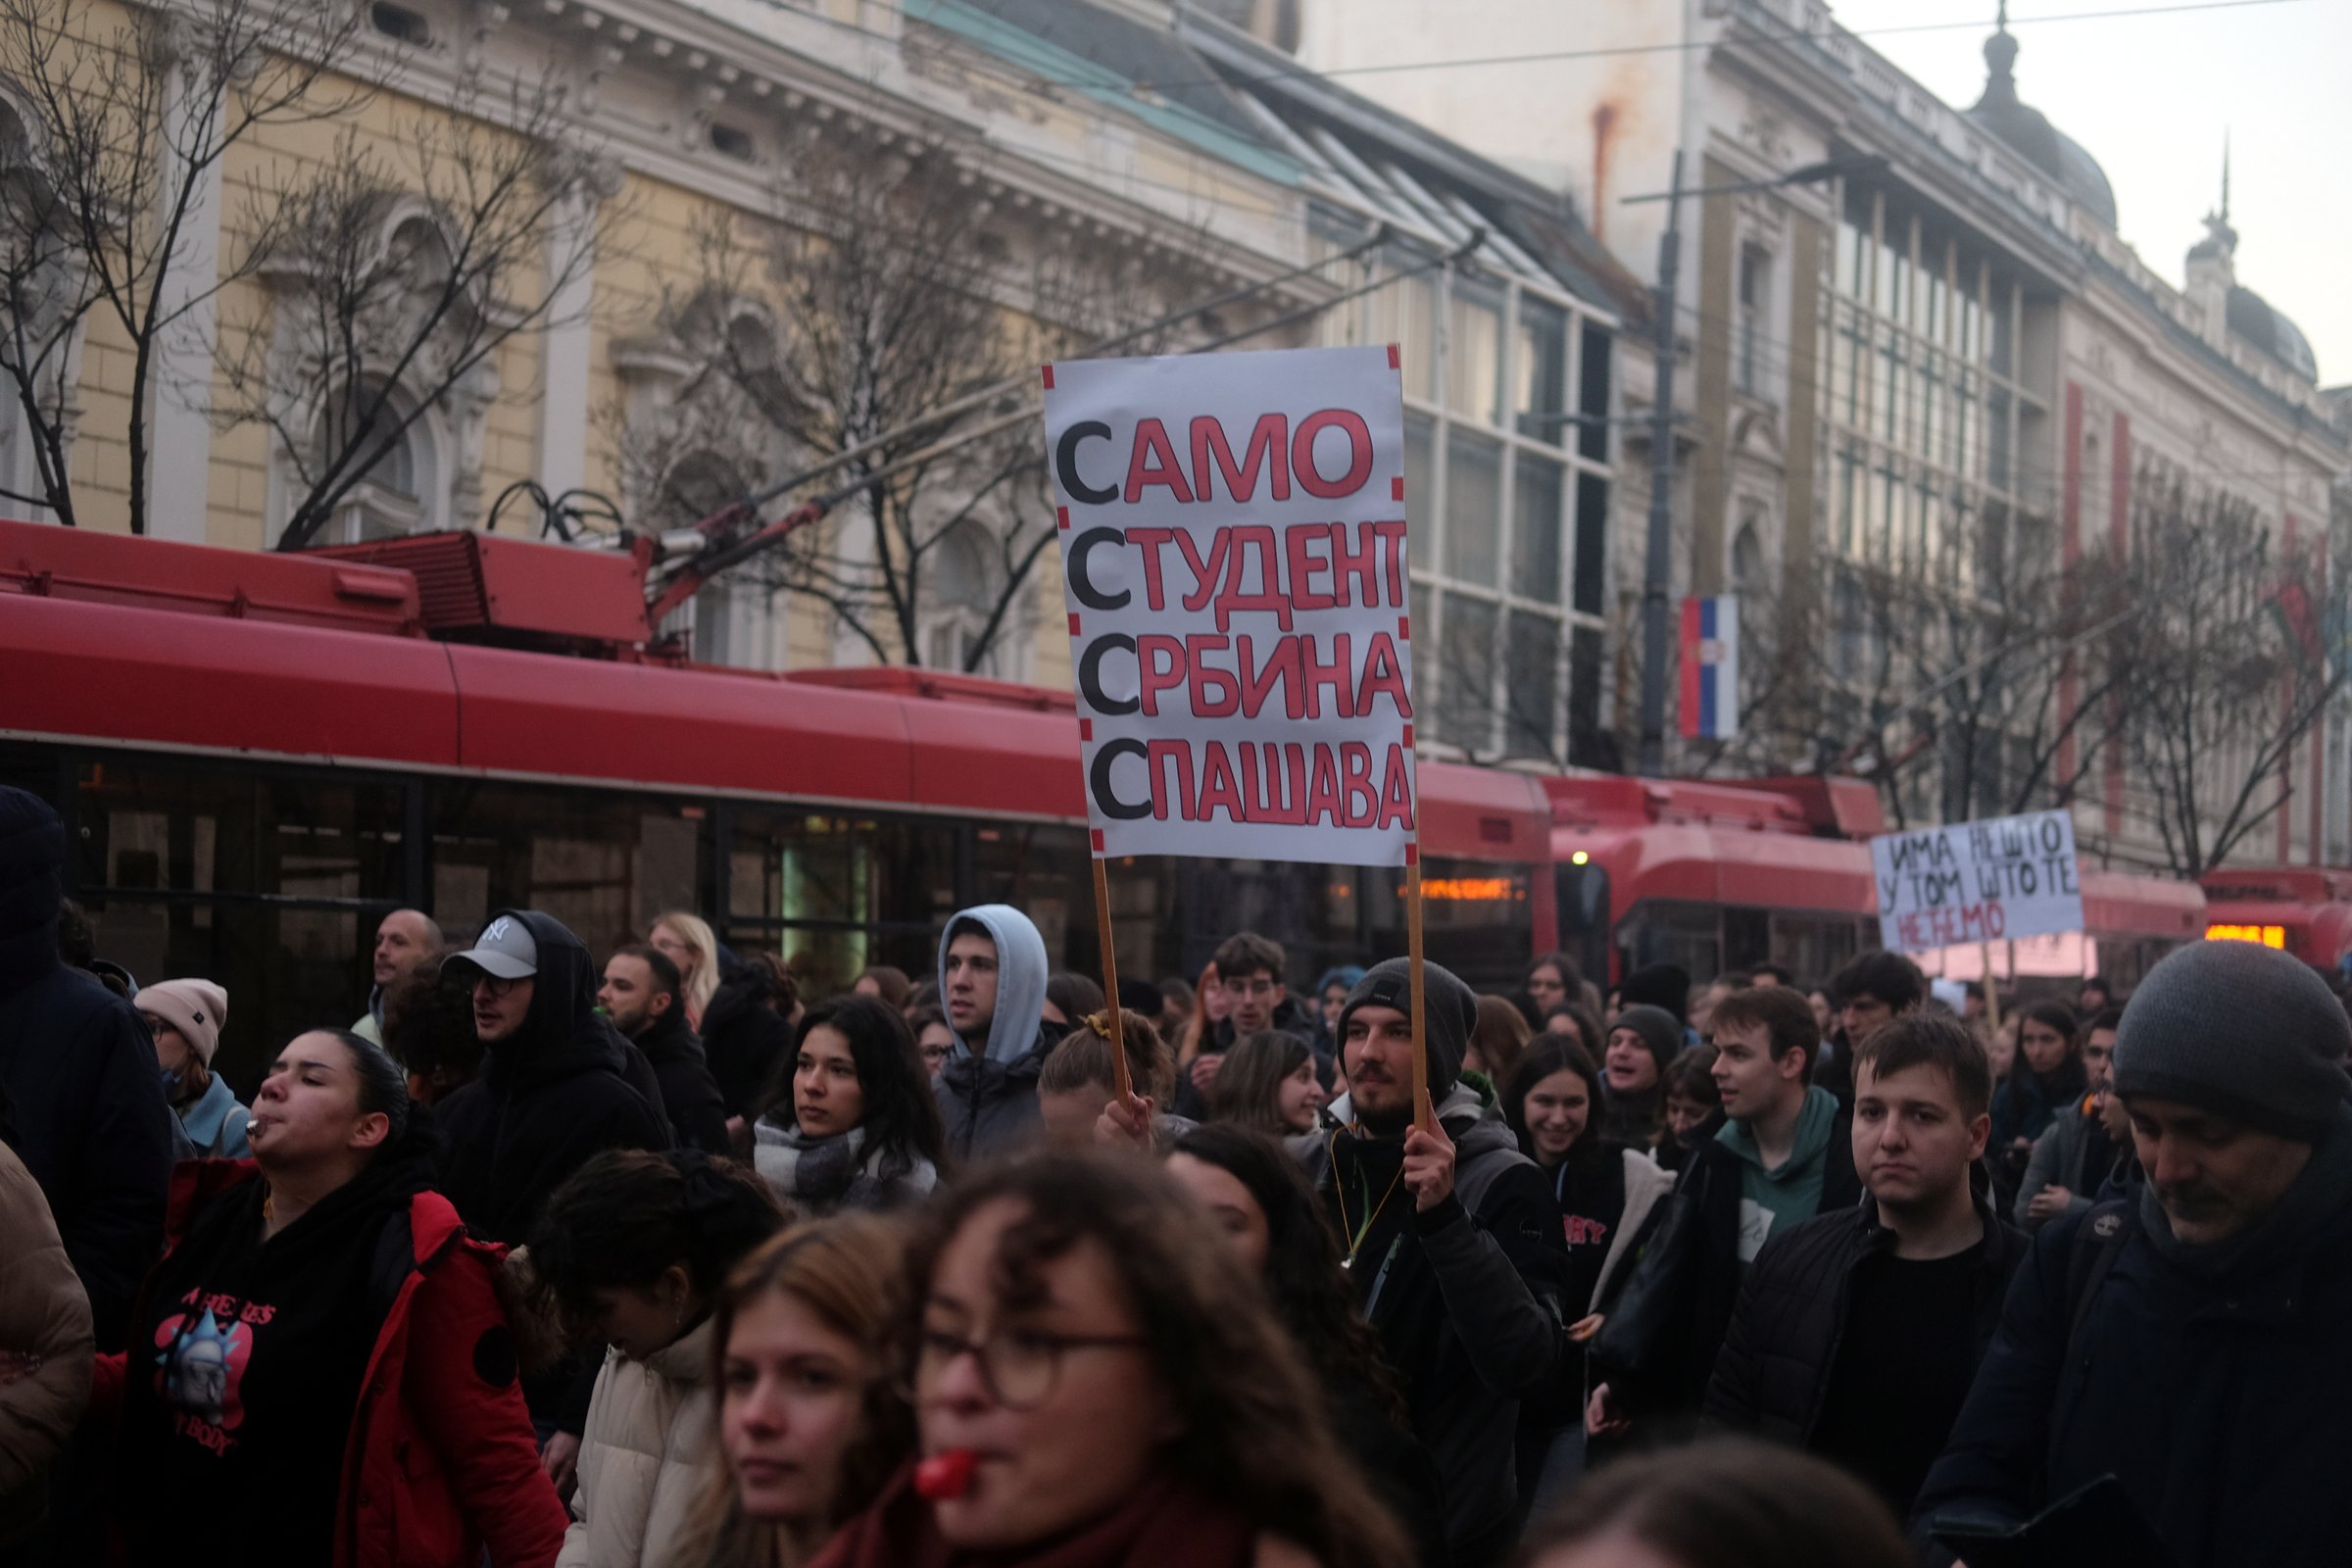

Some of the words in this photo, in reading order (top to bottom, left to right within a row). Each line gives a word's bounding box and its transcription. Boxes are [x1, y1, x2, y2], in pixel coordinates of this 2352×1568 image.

[1055, 409, 1373, 504] САМО
[1066, 521, 1407, 632] СТУДЕНТ
[1078, 632, 1413, 719] СРБИНА
[1089, 738, 1414, 830] СПАШАВА
[1888, 831, 1957, 871] ИМА
[1969, 817, 2062, 862] НЕШТО
[482, 919, 510, 941] NY
[1882, 875, 1899, 915] У
[1907, 869, 1965, 911] ТОМ
